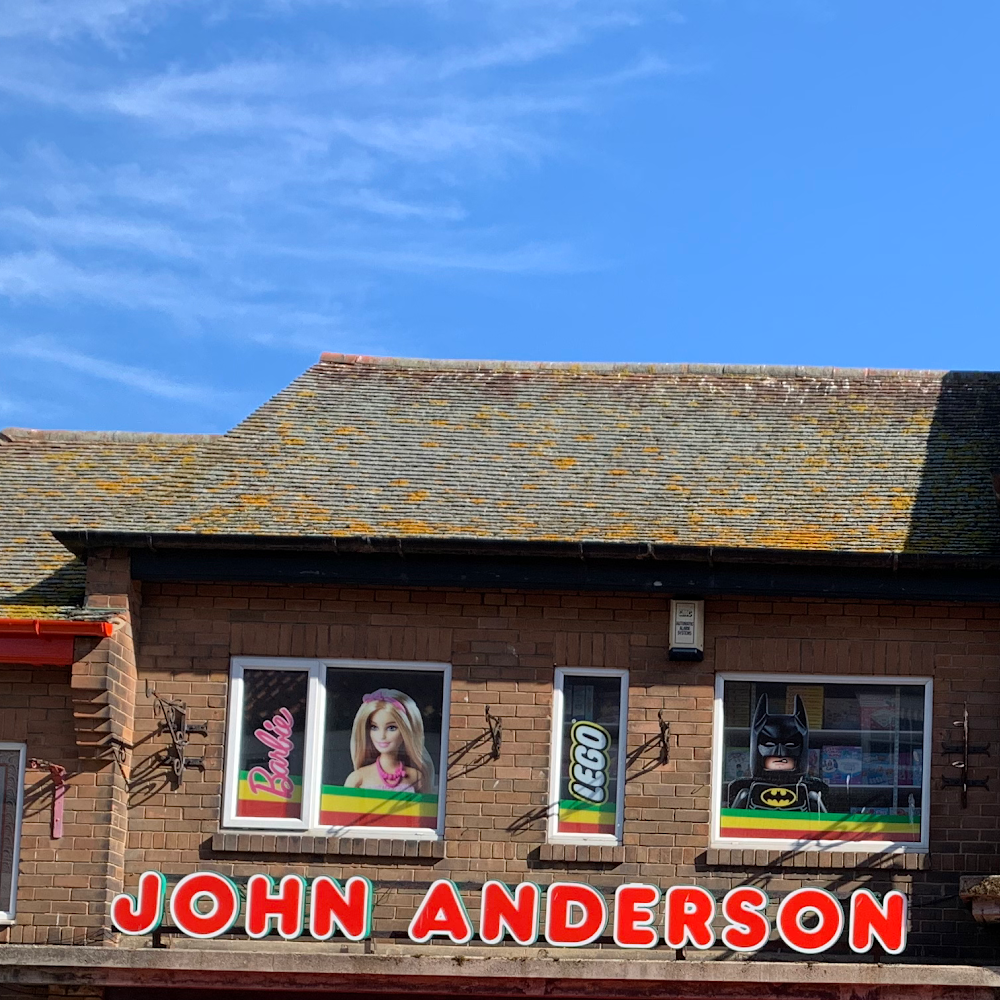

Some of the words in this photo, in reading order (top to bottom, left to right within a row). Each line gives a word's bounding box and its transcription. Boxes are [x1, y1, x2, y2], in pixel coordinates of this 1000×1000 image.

[247, 707, 295, 799] Barbie
[568, 720, 612, 806] LEGO
[110, 870, 373, 942] JOHN
[408, 878, 908, 955] ANDERSON
